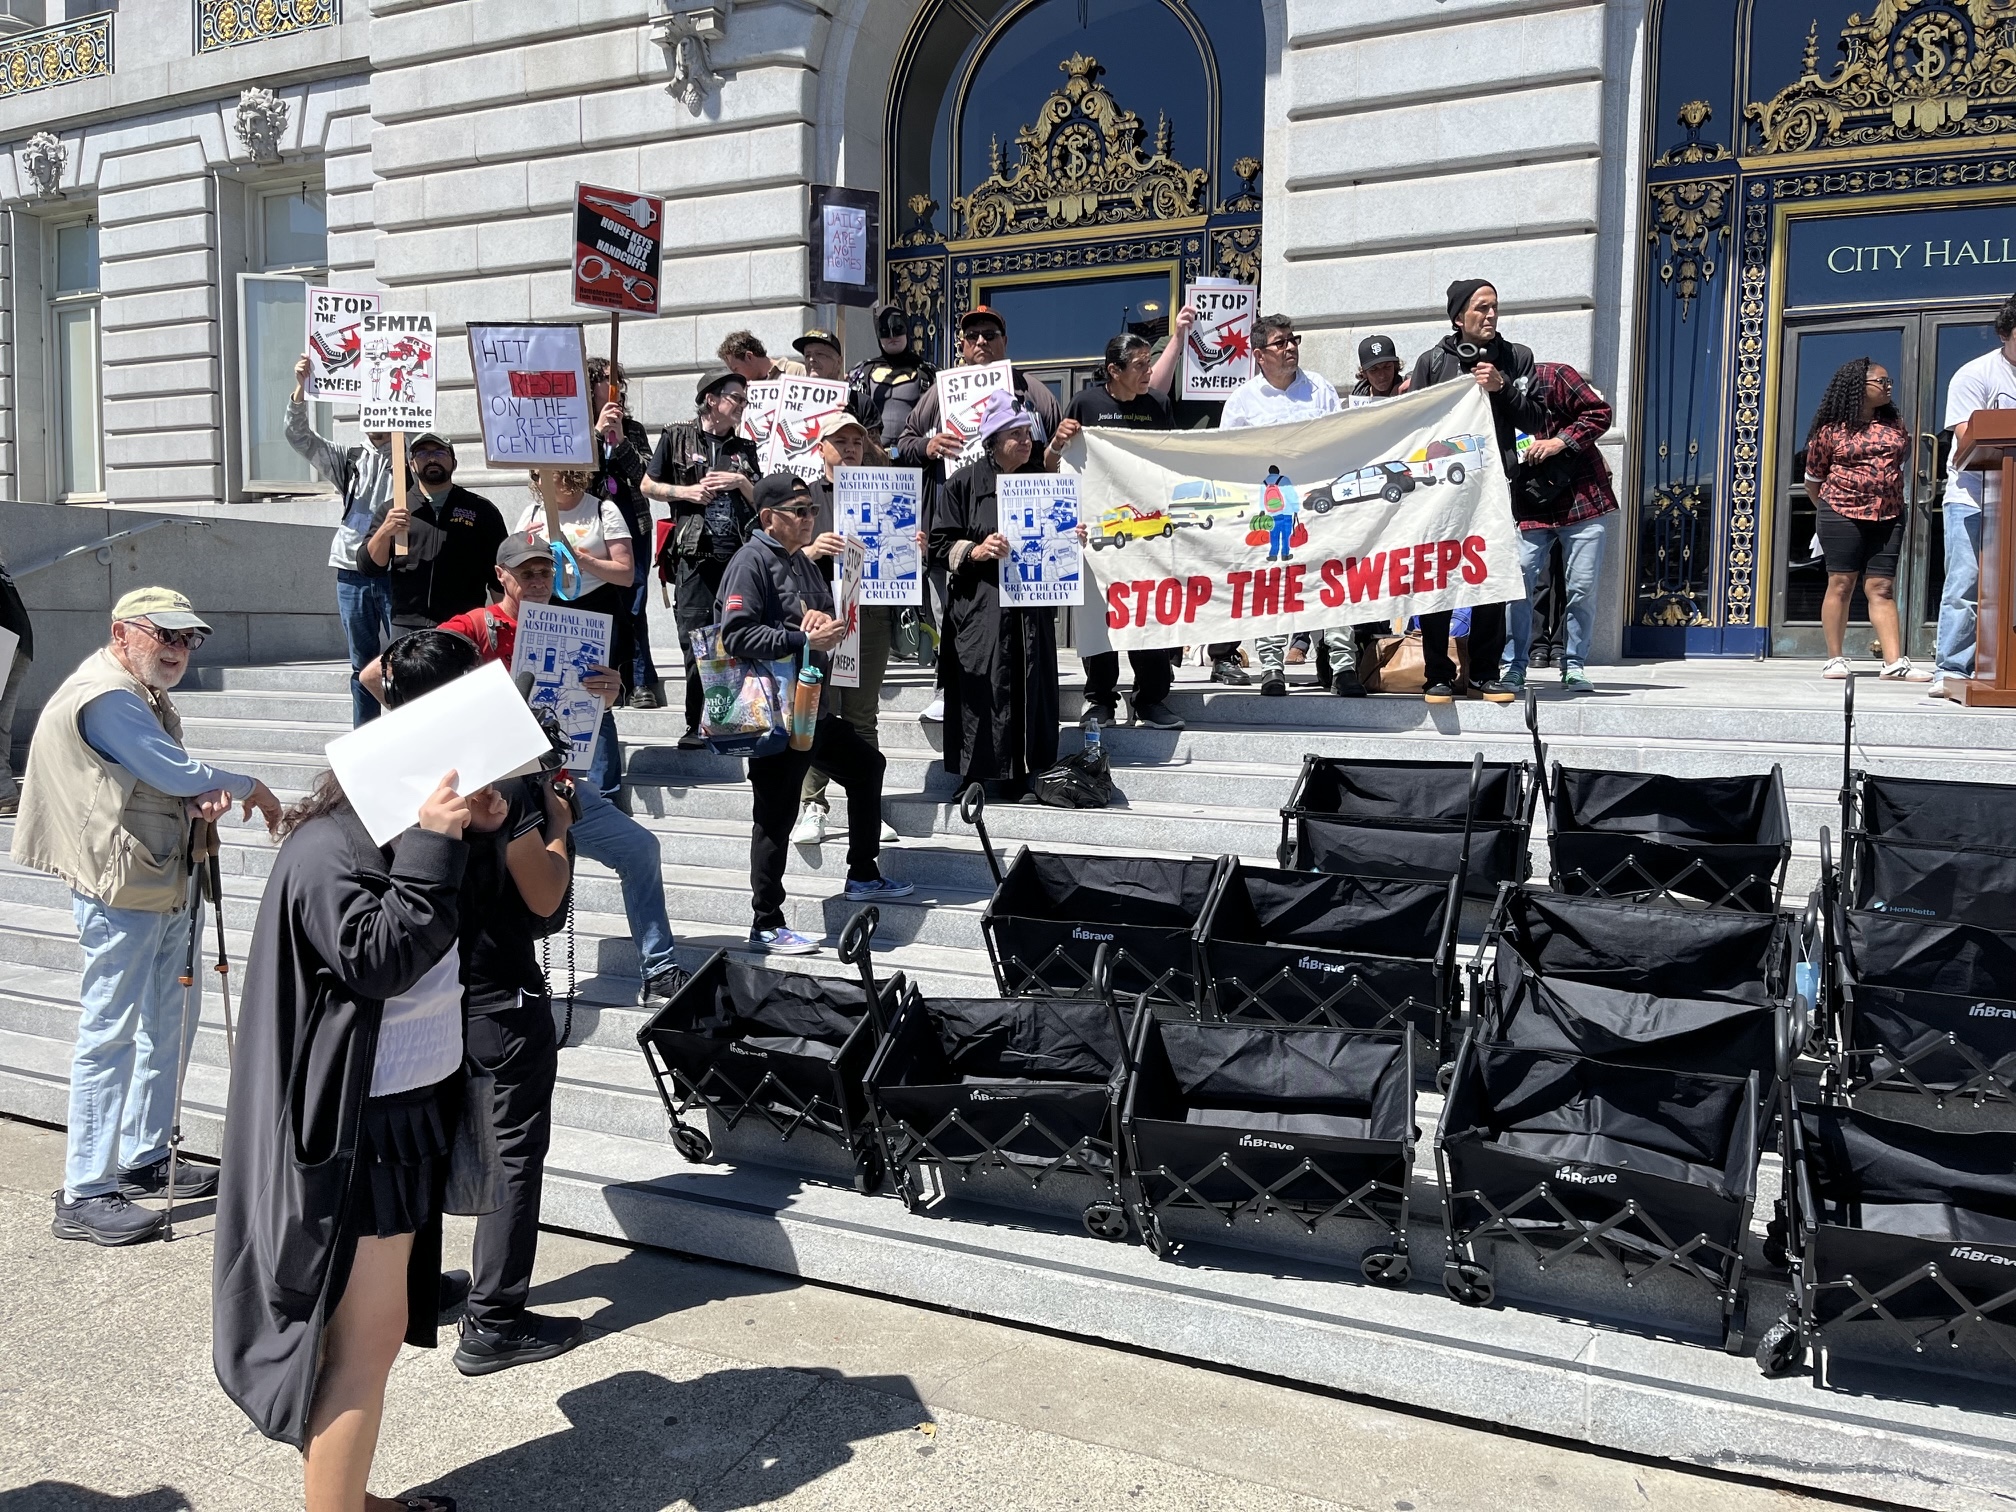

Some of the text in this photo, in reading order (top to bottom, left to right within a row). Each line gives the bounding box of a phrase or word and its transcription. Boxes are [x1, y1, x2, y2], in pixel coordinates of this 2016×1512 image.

[828, 213, 864, 230] JAILS
[600, 217, 653, 249] HOUSE KEYS
[832, 230, 856, 245] ARE
[596, 239, 648, 272] HANDCUFFS
[627, 242, 651, 260] NOT
[833, 245, 856, 257] NOT
[1827, 238, 2016, 274] CITY HALL
[827, 256, 862, 271] HOMES
[317, 296, 373, 314] STOP
[1196, 294, 1248, 310] STOP
[314, 312, 336, 324] THE
[364, 316, 433, 332] SFMTA
[481, 340, 530, 363] HIT
[314, 377, 361, 392] SWEEP
[511, 373, 570, 396] RESET
[948, 371, 1001, 393] STOP
[1191, 376, 1246, 389] SWEEPS
[750, 387, 779, 400] STO
[789, 385, 838, 404] STOP
[947, 392, 968, 404] THE
[364, 406, 432, 417] Don't Take
[491, 395, 568, 417] ON THE
[748, 401, 763, 410] THE
[785, 401, 803, 412] THE
[363, 418, 432, 428] Our Homes
[516, 417, 578, 437] RESET
[497, 435, 574, 455] CENTER
[841, 472, 850, 480] SF
[852, 472, 869, 480] CITY
[895, 473, 915, 482] YOUR
[1003, 480, 1012, 488] SF
[1015, 479, 1032, 487] CITY
[839, 481, 916, 490] AUSTERITY IS FUTILE
[1002, 488, 1040, 496] AUSTERITY
[1053, 487, 1076, 495] FUTILE
[847, 547, 861, 571] STOP
[872, 581, 887, 590] THE
[889, 581, 917, 590] CYCLE
[1005, 582, 1079, 592] BREAK THE CYCLE
[1105, 535, 1488, 629] STOP THE SWEEPS
[865, 591, 907, 599] CRUELTY
[1014, 592, 1070, 601] OF CRUELTY
[527, 609, 538, 619] SF
[540, 611, 559, 622] CITY
[585, 618, 605, 629] YOUR
[523, 619, 606, 640] AUSTERITY IS FUTILE
[1889, 906, 1936, 916] Hombetta
[1072, 926, 1114, 941] InBrave
[1298, 956, 1345, 974] InBrave
[1969, 1003, 2016, 1019] InBra
[1239, 1134, 1295, 1151] InBrave
